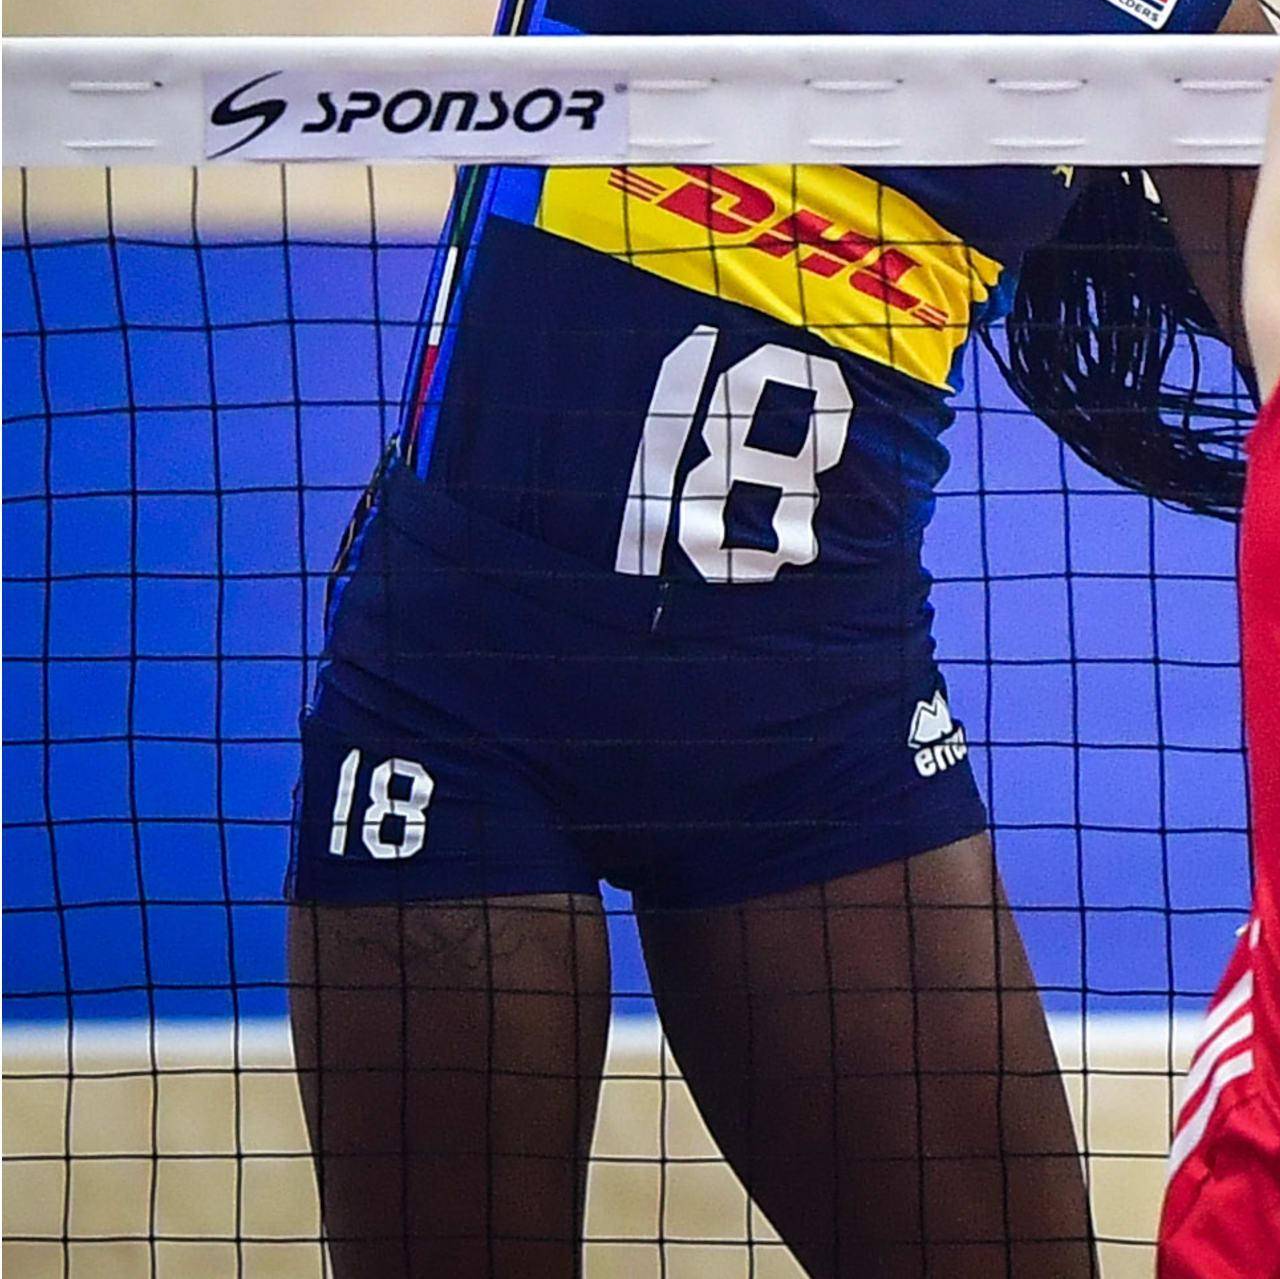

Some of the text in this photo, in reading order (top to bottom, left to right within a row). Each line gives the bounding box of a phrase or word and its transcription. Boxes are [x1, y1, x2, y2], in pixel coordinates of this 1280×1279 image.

[302, 88, 605, 134] SPONSOR
[657, 165, 922, 311] DHL
[614, 324, 854, 585] 18
[329, 748, 435, 859] 18
